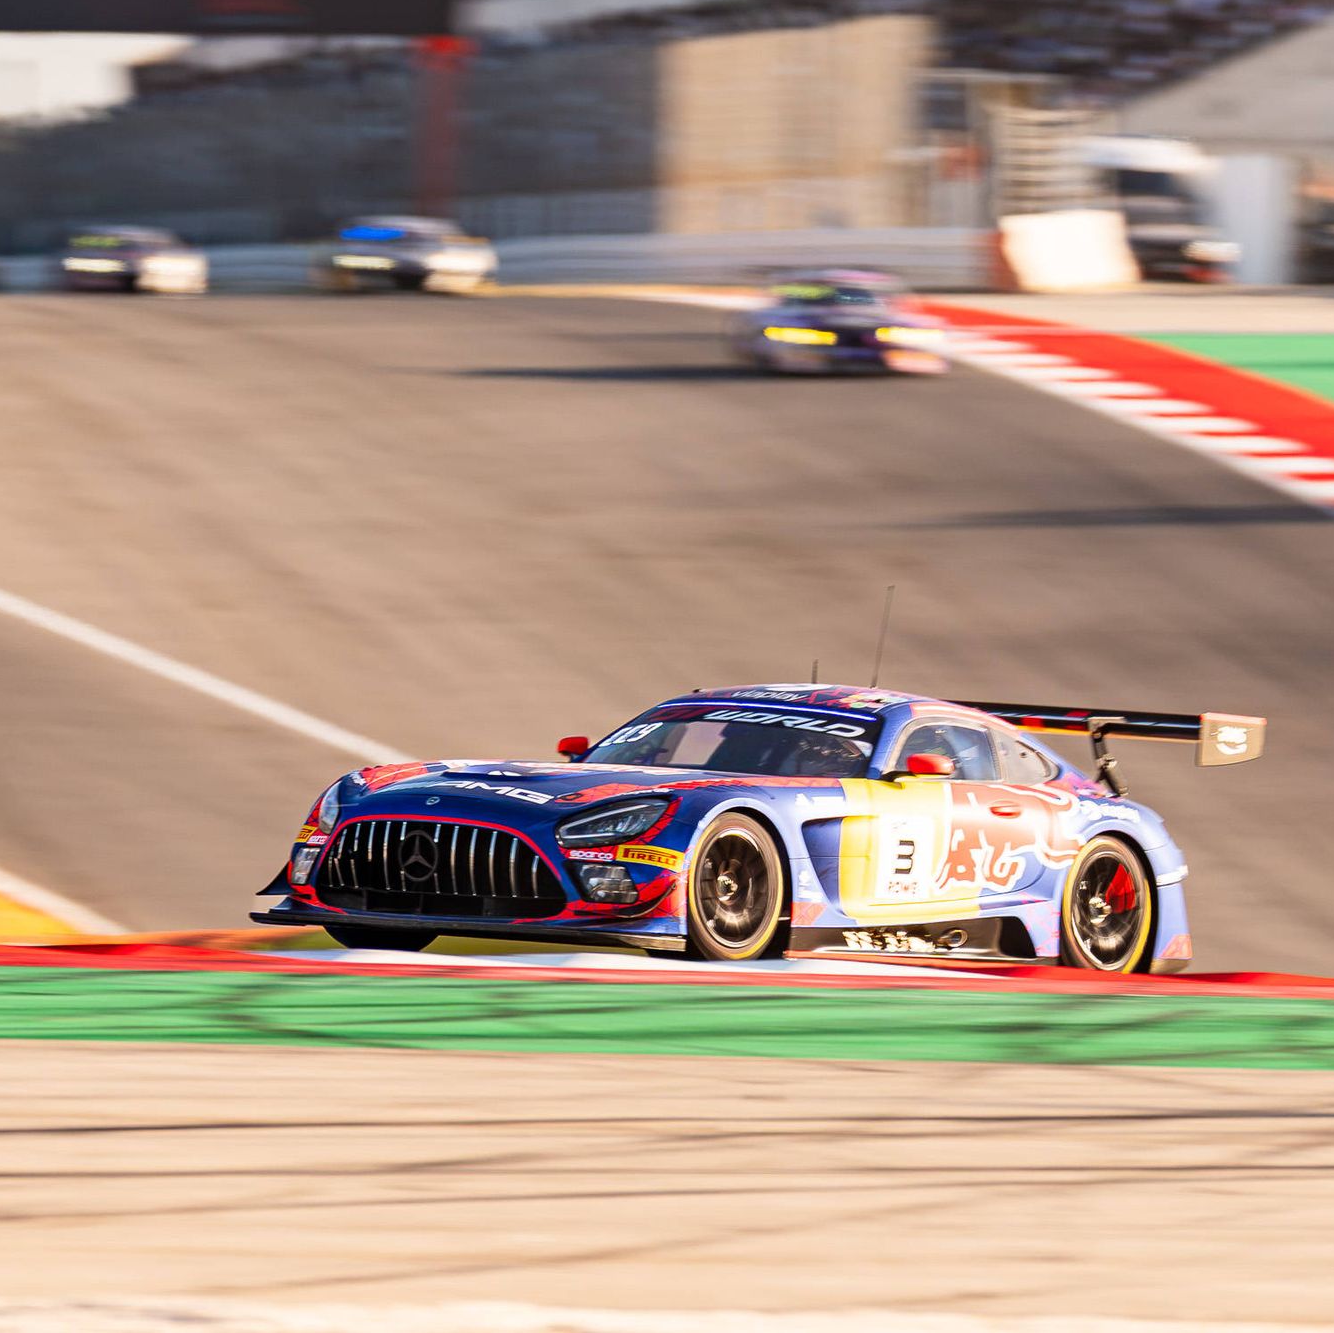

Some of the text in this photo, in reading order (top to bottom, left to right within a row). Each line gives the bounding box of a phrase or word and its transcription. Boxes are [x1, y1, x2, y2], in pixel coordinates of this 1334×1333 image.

[703, 710, 866, 738] WORLD
[429, 781, 554, 804] AMG
[570, 850, 614, 860] sparco
[623, 848, 677, 866] PIRELLI
[895, 840, 915, 875] 3
